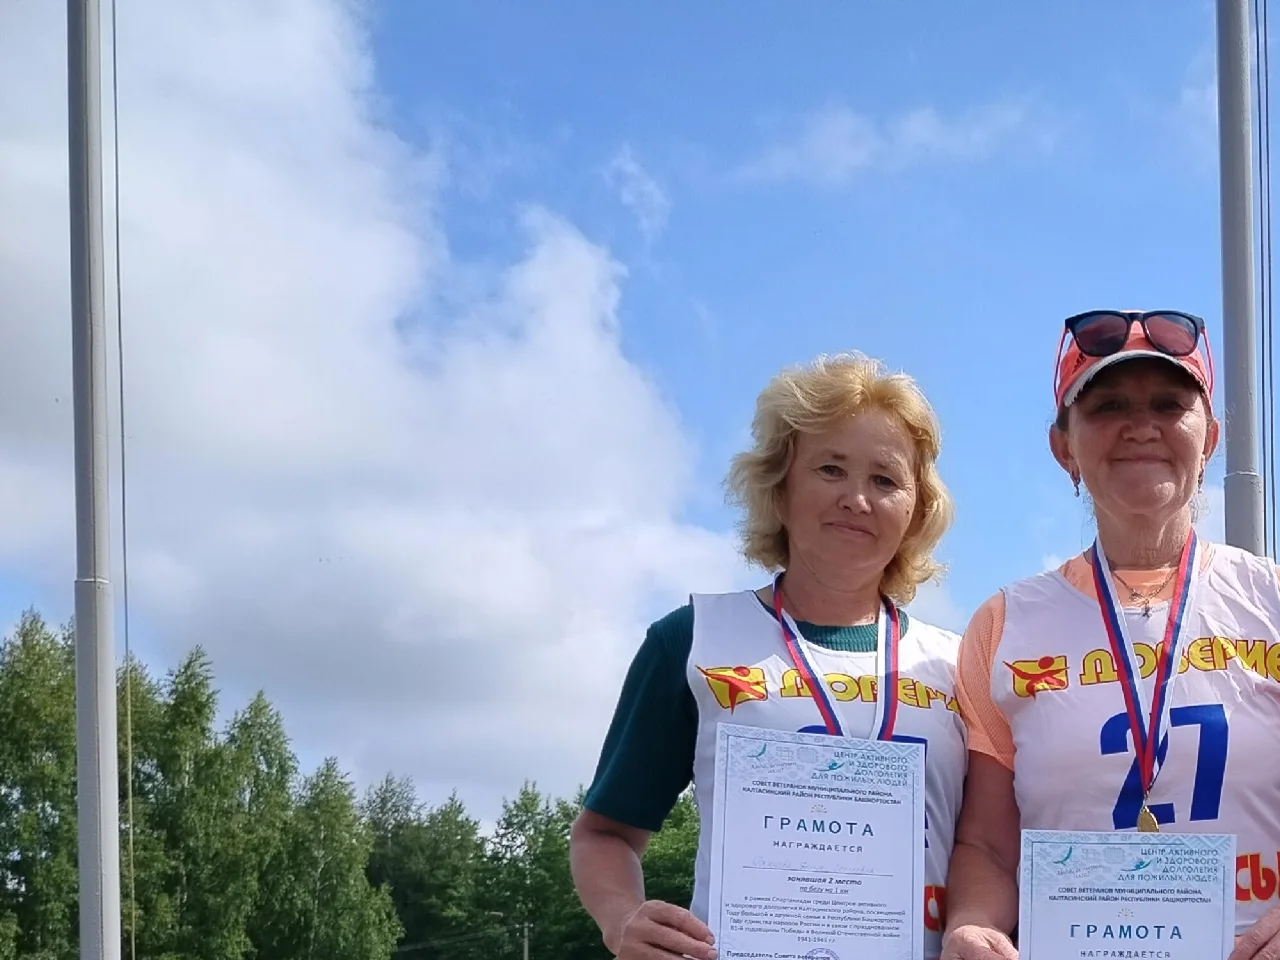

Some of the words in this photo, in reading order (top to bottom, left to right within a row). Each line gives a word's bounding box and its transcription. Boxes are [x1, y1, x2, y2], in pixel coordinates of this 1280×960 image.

[834, 751, 859, 760] ЦЕНТР
[861, 753, 907, 764] АКТИВНОГО
[856, 760, 907, 772] ЗДОРОВОГО
[1100, 704, 1228, 830] 27
[810, 772, 828, 780] ДЛЯ
[831, 774, 874, 784] ПОЖИЛЫХ
[876, 778, 907, 787] ЛЮДЕЙ
[854, 768, 907, 779] ДОЛГОЛЕТИЯ
[763, 815, 873, 836] ГРАМОТА
[772, 840, 862, 853] НАГРАЖДАЕТСЯ
[1140, 847, 1165, 855] ЦЕНТР
[1168, 848, 1217, 857] АКТИВНОГО
[1156, 856, 1161, 864] И
[1164, 857, 1218, 865] ЗДОРОВОГО
[1162, 865, 1218, 874] ДОЛГОЛЕТИЯ
[1117, 873, 1135, 881] ДЛЯ
[1137, 873, 1182, 882] ПОЖИЛЫХ
[1185, 875, 1217, 883] ЛЮДЕЙ
[1070, 923, 1182, 940] ГРАМОТА
[1080, 949, 1170, 959] НАГРАЖДАЕТСЯ
